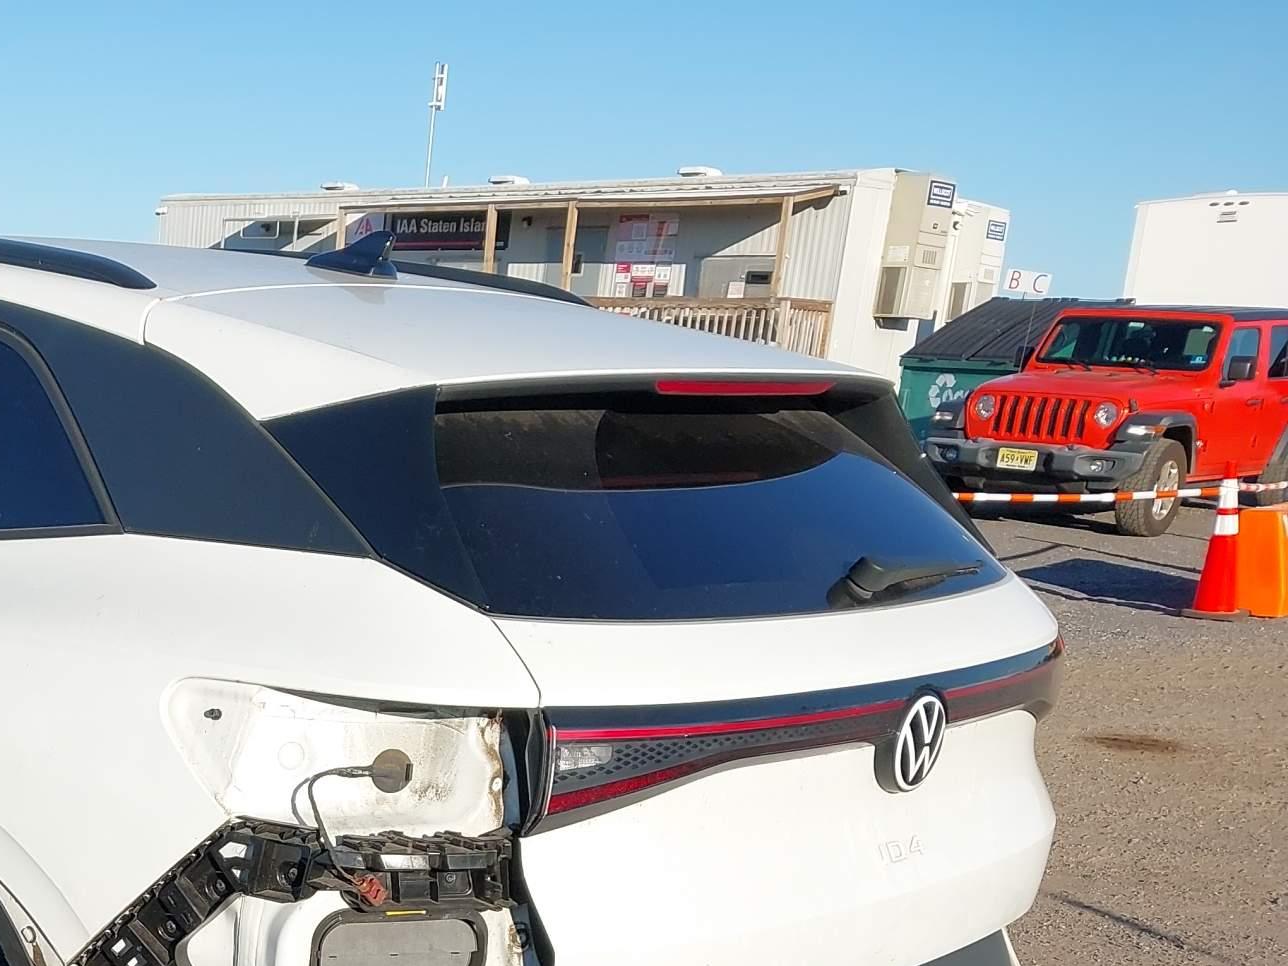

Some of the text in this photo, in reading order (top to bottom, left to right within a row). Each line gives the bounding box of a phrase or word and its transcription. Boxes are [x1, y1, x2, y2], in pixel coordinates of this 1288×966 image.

[396, 218, 417, 234] IAA
[419, 217, 457, 233] Staten
[1008, 270, 1048, 294] B C
